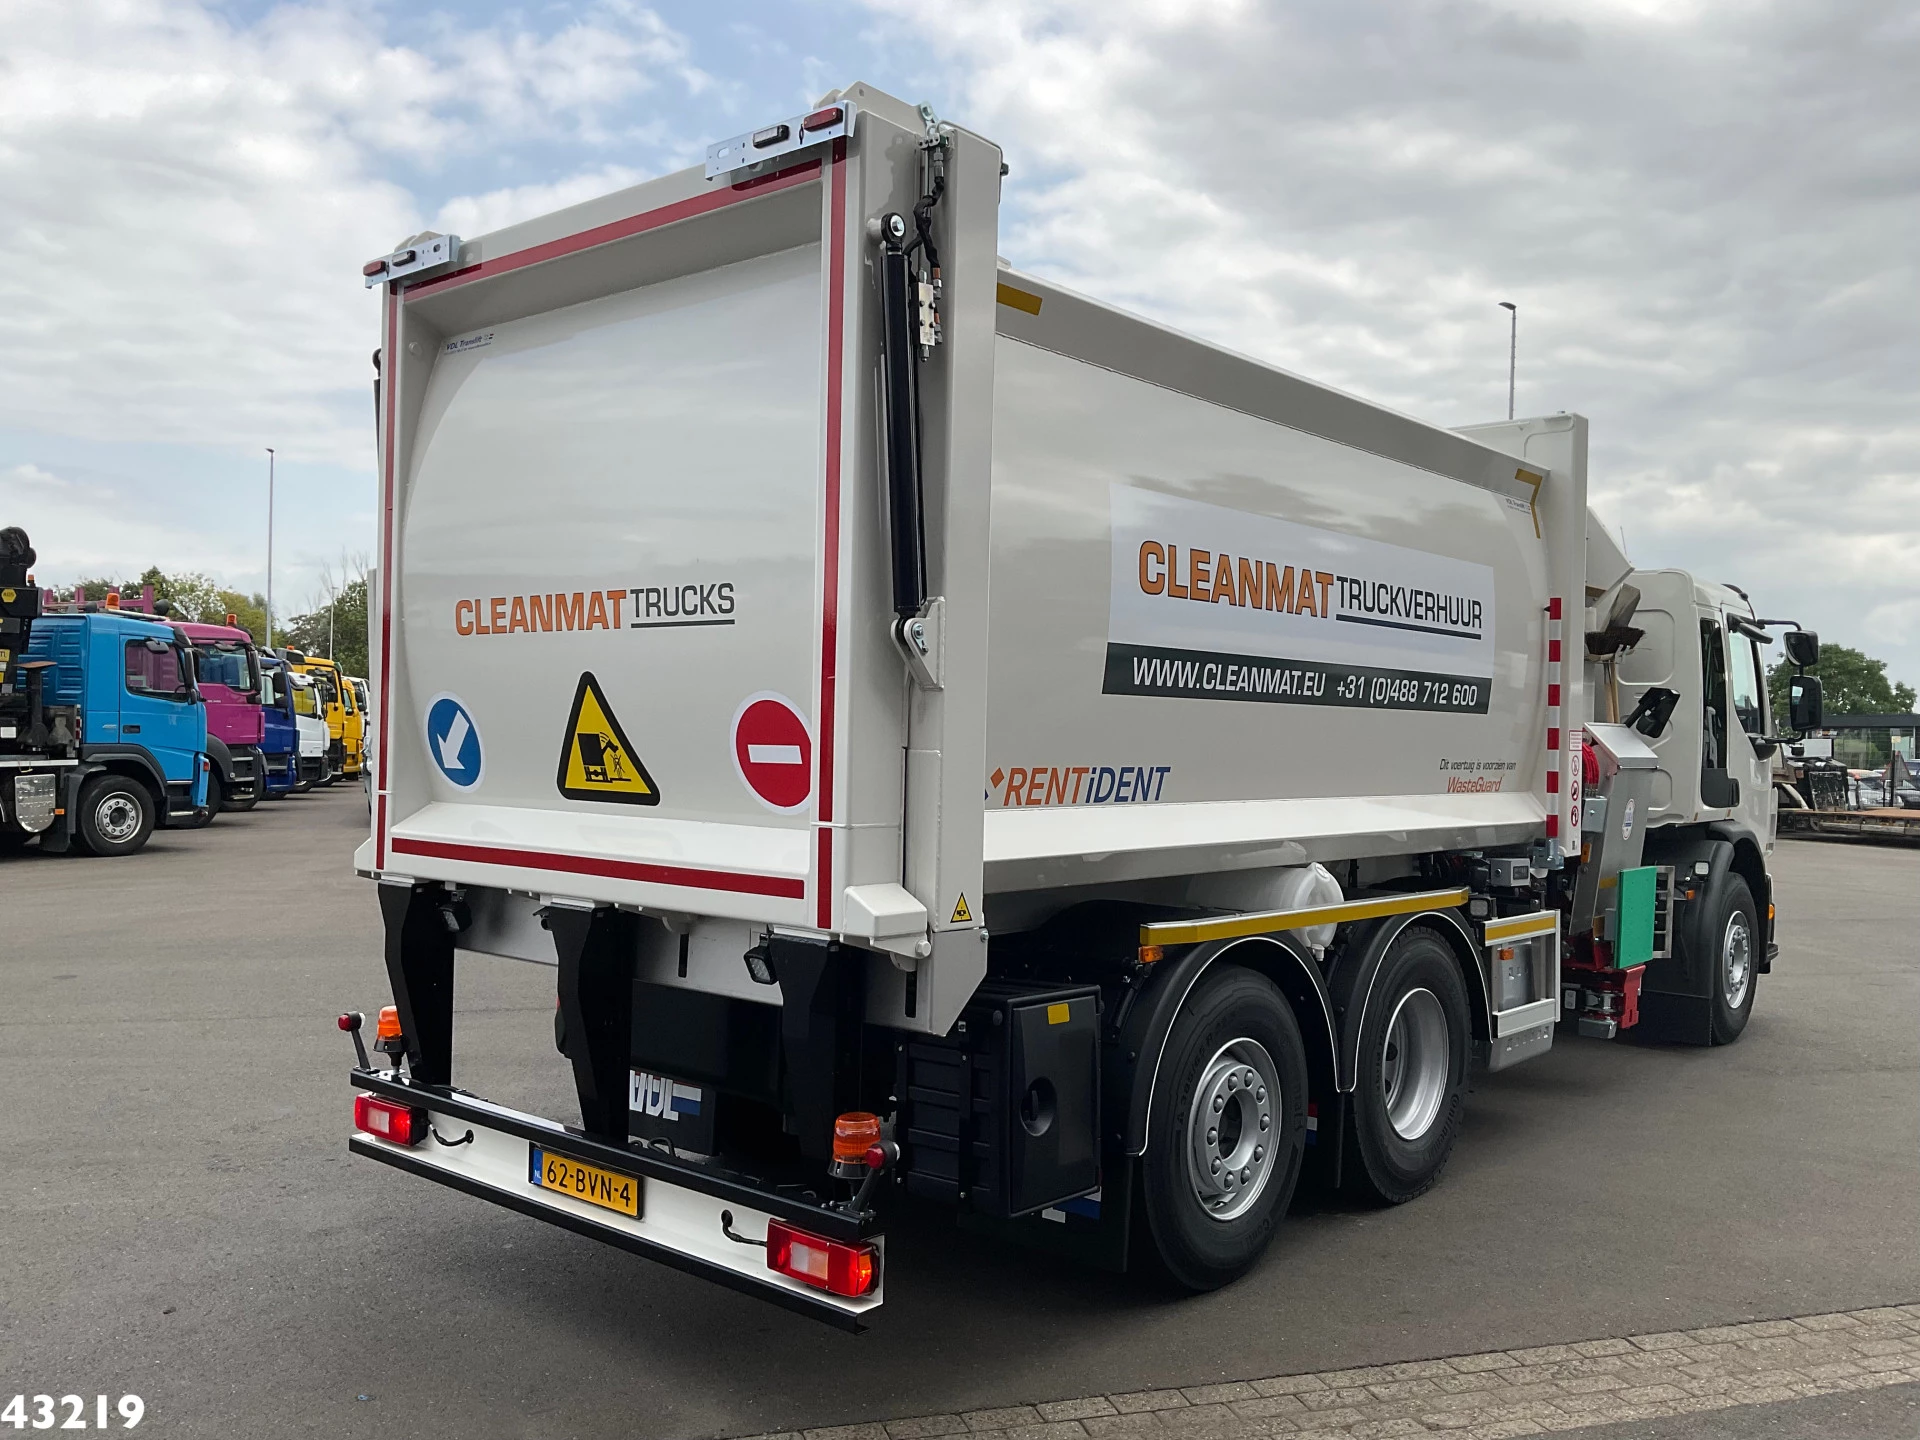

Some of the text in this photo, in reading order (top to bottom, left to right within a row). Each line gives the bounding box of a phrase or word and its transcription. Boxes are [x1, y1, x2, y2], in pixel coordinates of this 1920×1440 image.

[454, 582, 736, 637] CLEANMAT TRUCKS
[1138, 540, 1483, 630] CLEANMAT TRUCKVERHUUR
[1132, 656, 1478, 707] WWW.CLEANMAT.EU +31 (0)488 712 600
[1439, 758, 1517, 773] Dit voertuig is voorzien van
[1446, 776, 1503, 793] WasteGuard
[629, 1069, 679, 1121] VDL
[546, 1160, 631, 1208] 62-BVN-4
